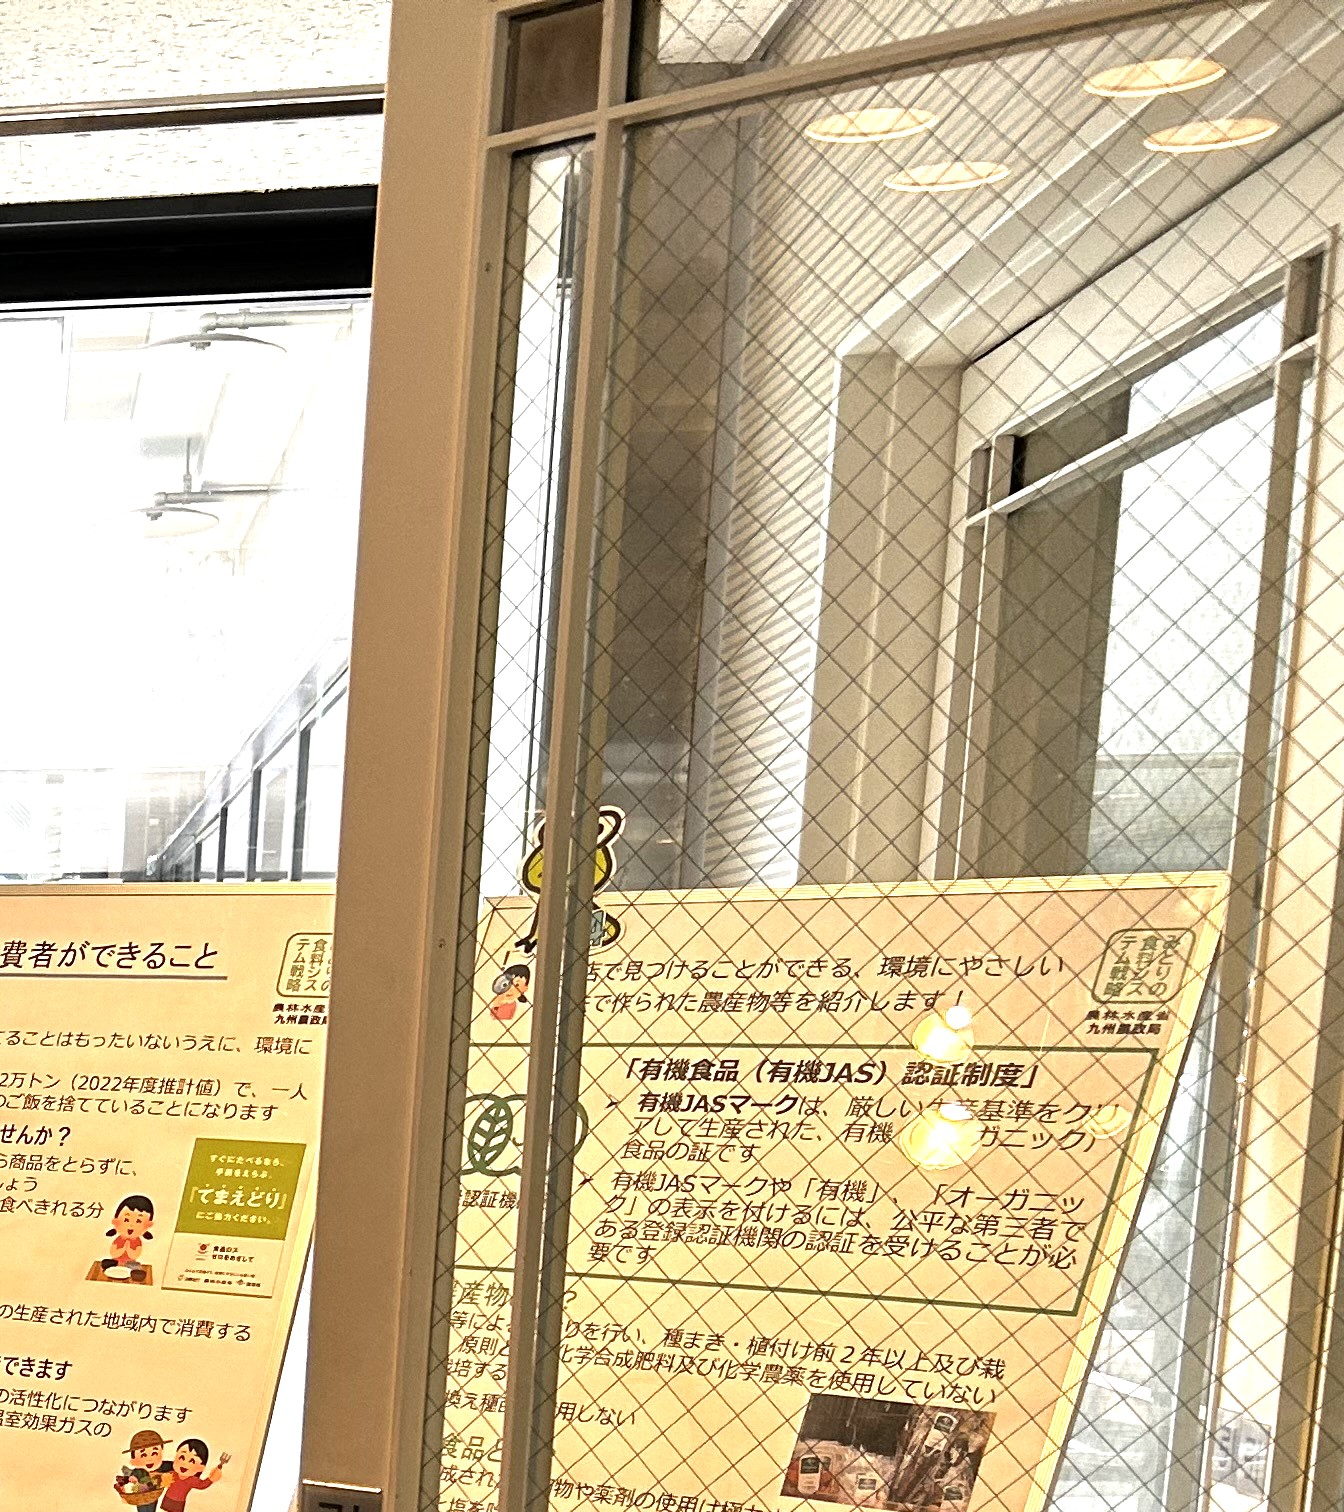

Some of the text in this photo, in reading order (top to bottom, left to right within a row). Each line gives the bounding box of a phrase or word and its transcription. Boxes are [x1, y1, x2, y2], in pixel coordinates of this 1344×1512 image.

[621, 1140, 758, 1164] 食品の証です
[589, 1242, 656, 1265] 要です
[595, 1218, 1077, 1270] ある登録認証機関の認証を受けることが必
